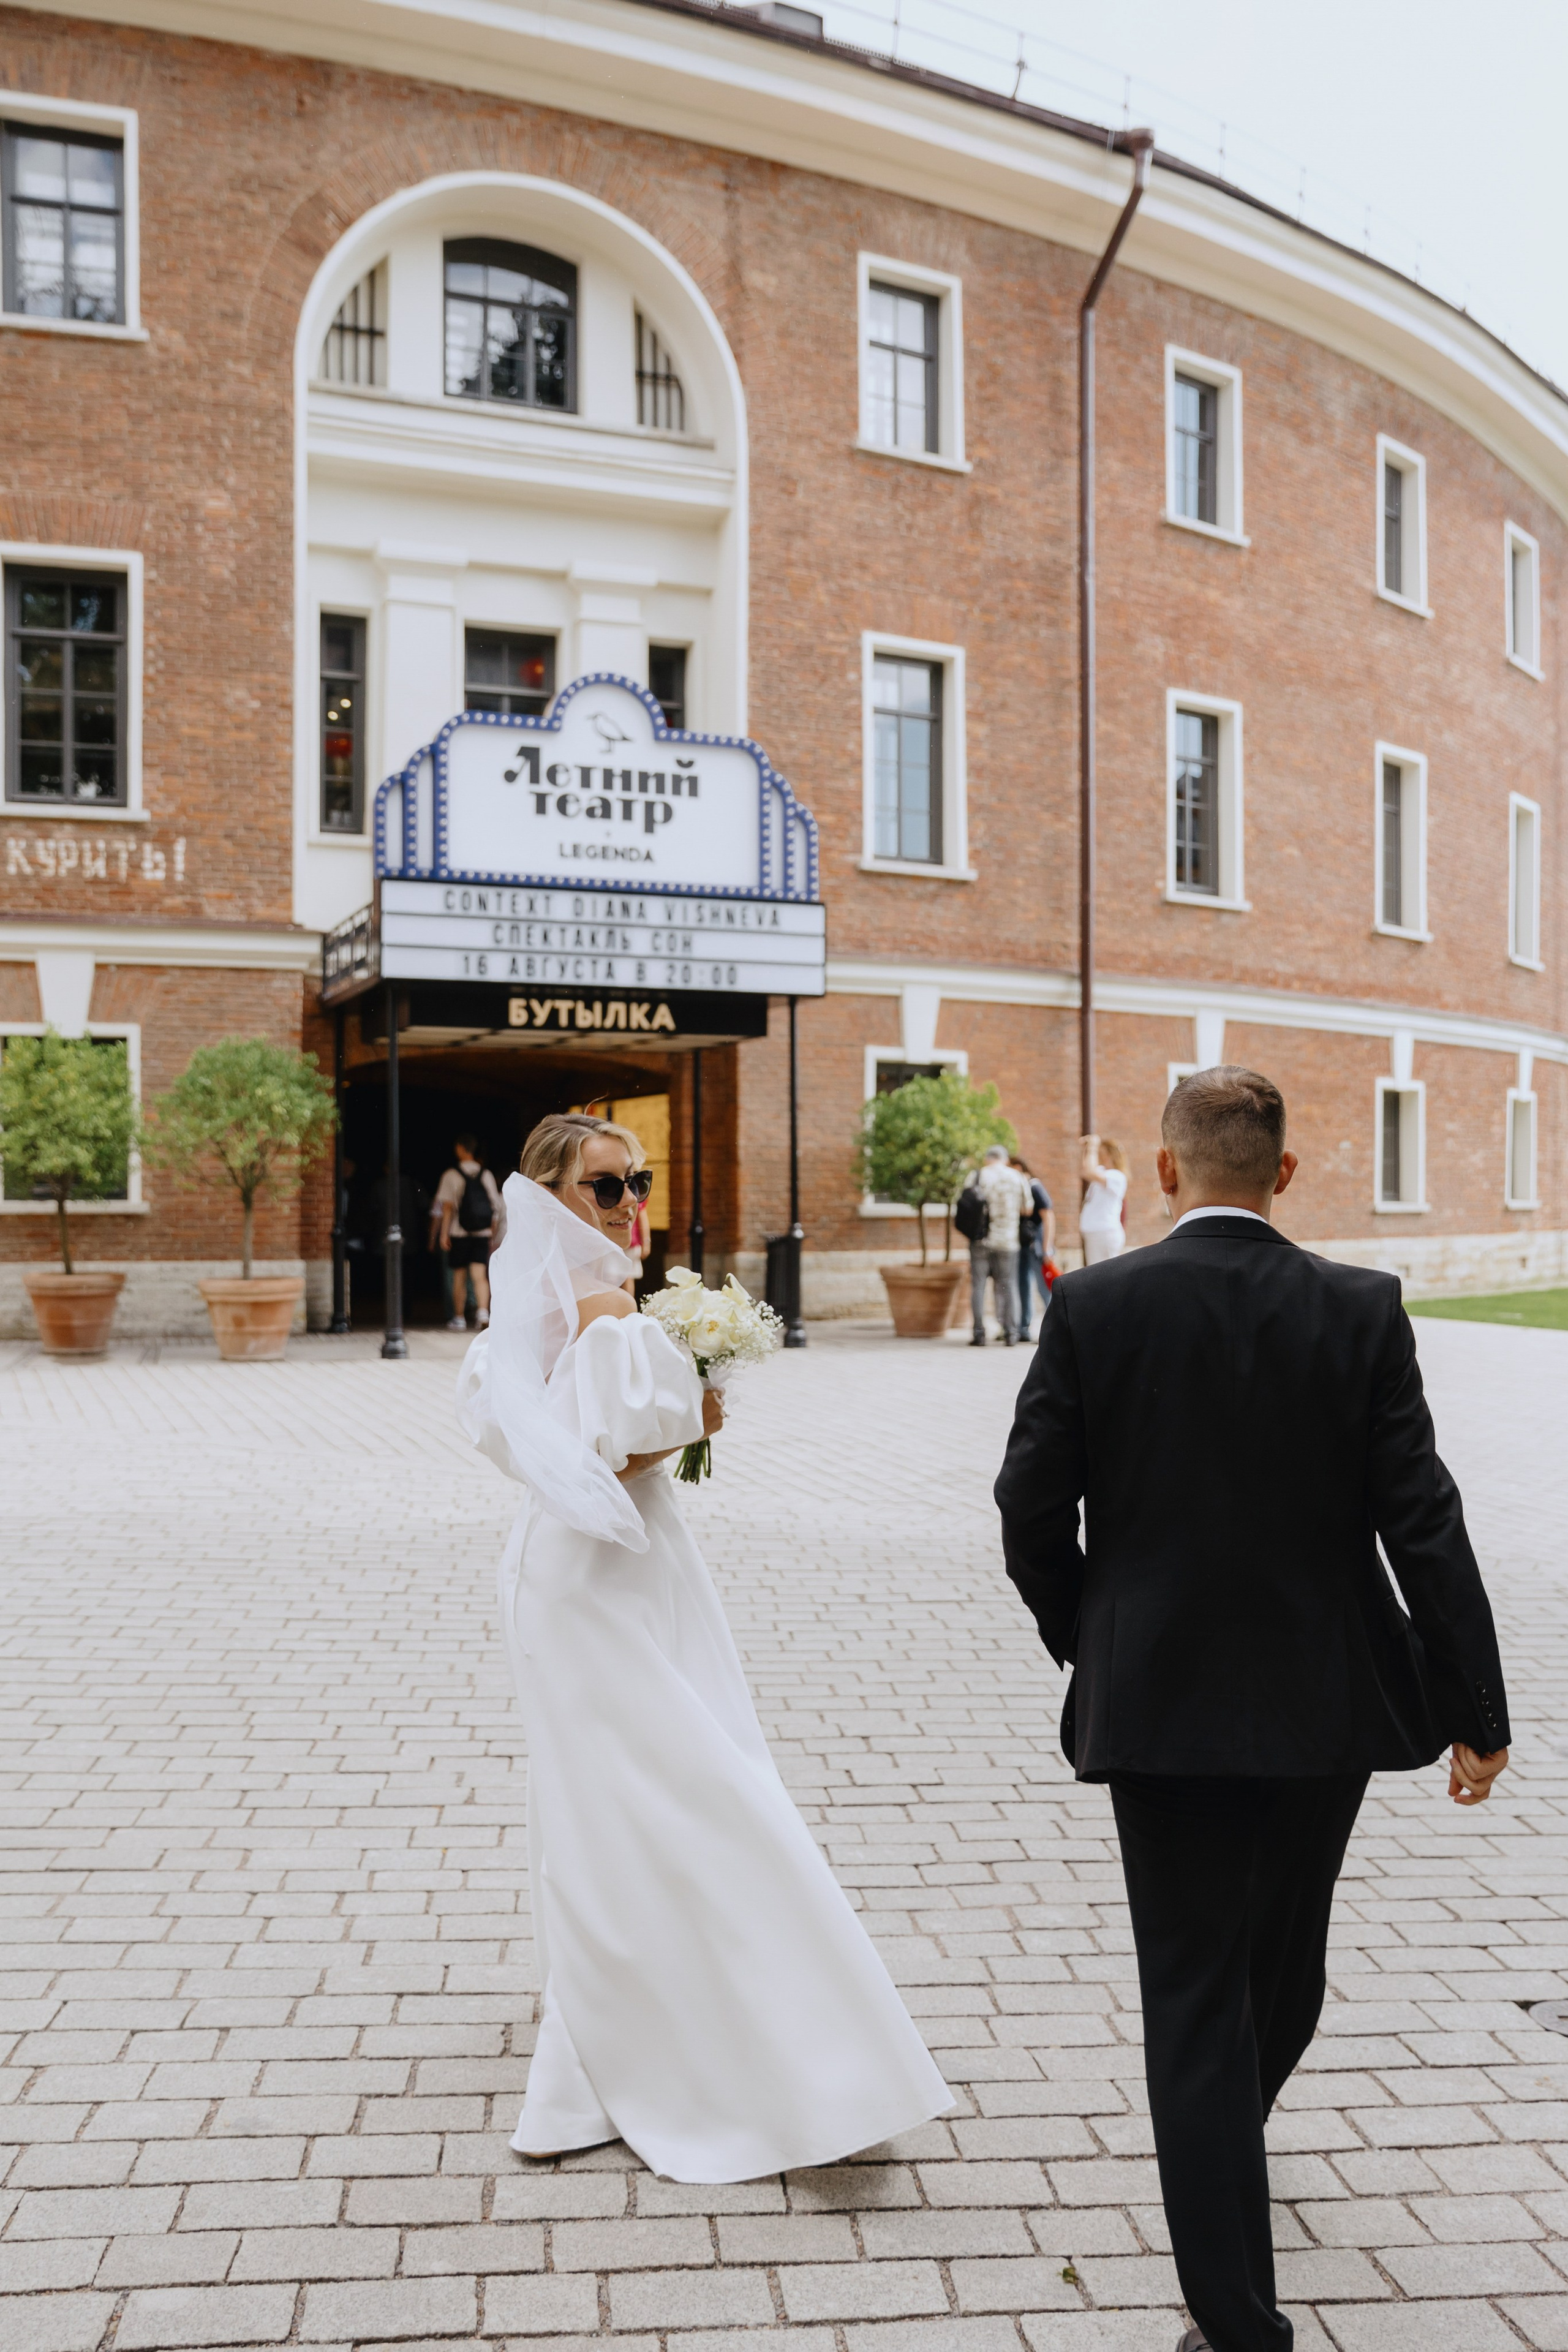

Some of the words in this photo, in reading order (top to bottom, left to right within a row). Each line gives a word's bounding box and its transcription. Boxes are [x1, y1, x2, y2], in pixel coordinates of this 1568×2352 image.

[503, 745, 699, 797] Летний
[529, 789, 673, 834] театр
[559, 843, 654, 864] LEGENDA
[443, 889, 554, 917] CONTEXT
[573, 897, 646, 921] DIANA
[665, 902, 780, 927] VISHNEVA
[493, 922, 631, 951] СПЕКТАКЛЬ
[652, 932, 693, 954] СОН
[463, 956, 488, 976] 16
[510, 956, 615, 981] АВГУСТА
[635, 962, 646, 981] В
[666, 963, 737, 987] 20:00
[508, 997, 676, 1031] БУТЫЛКА
